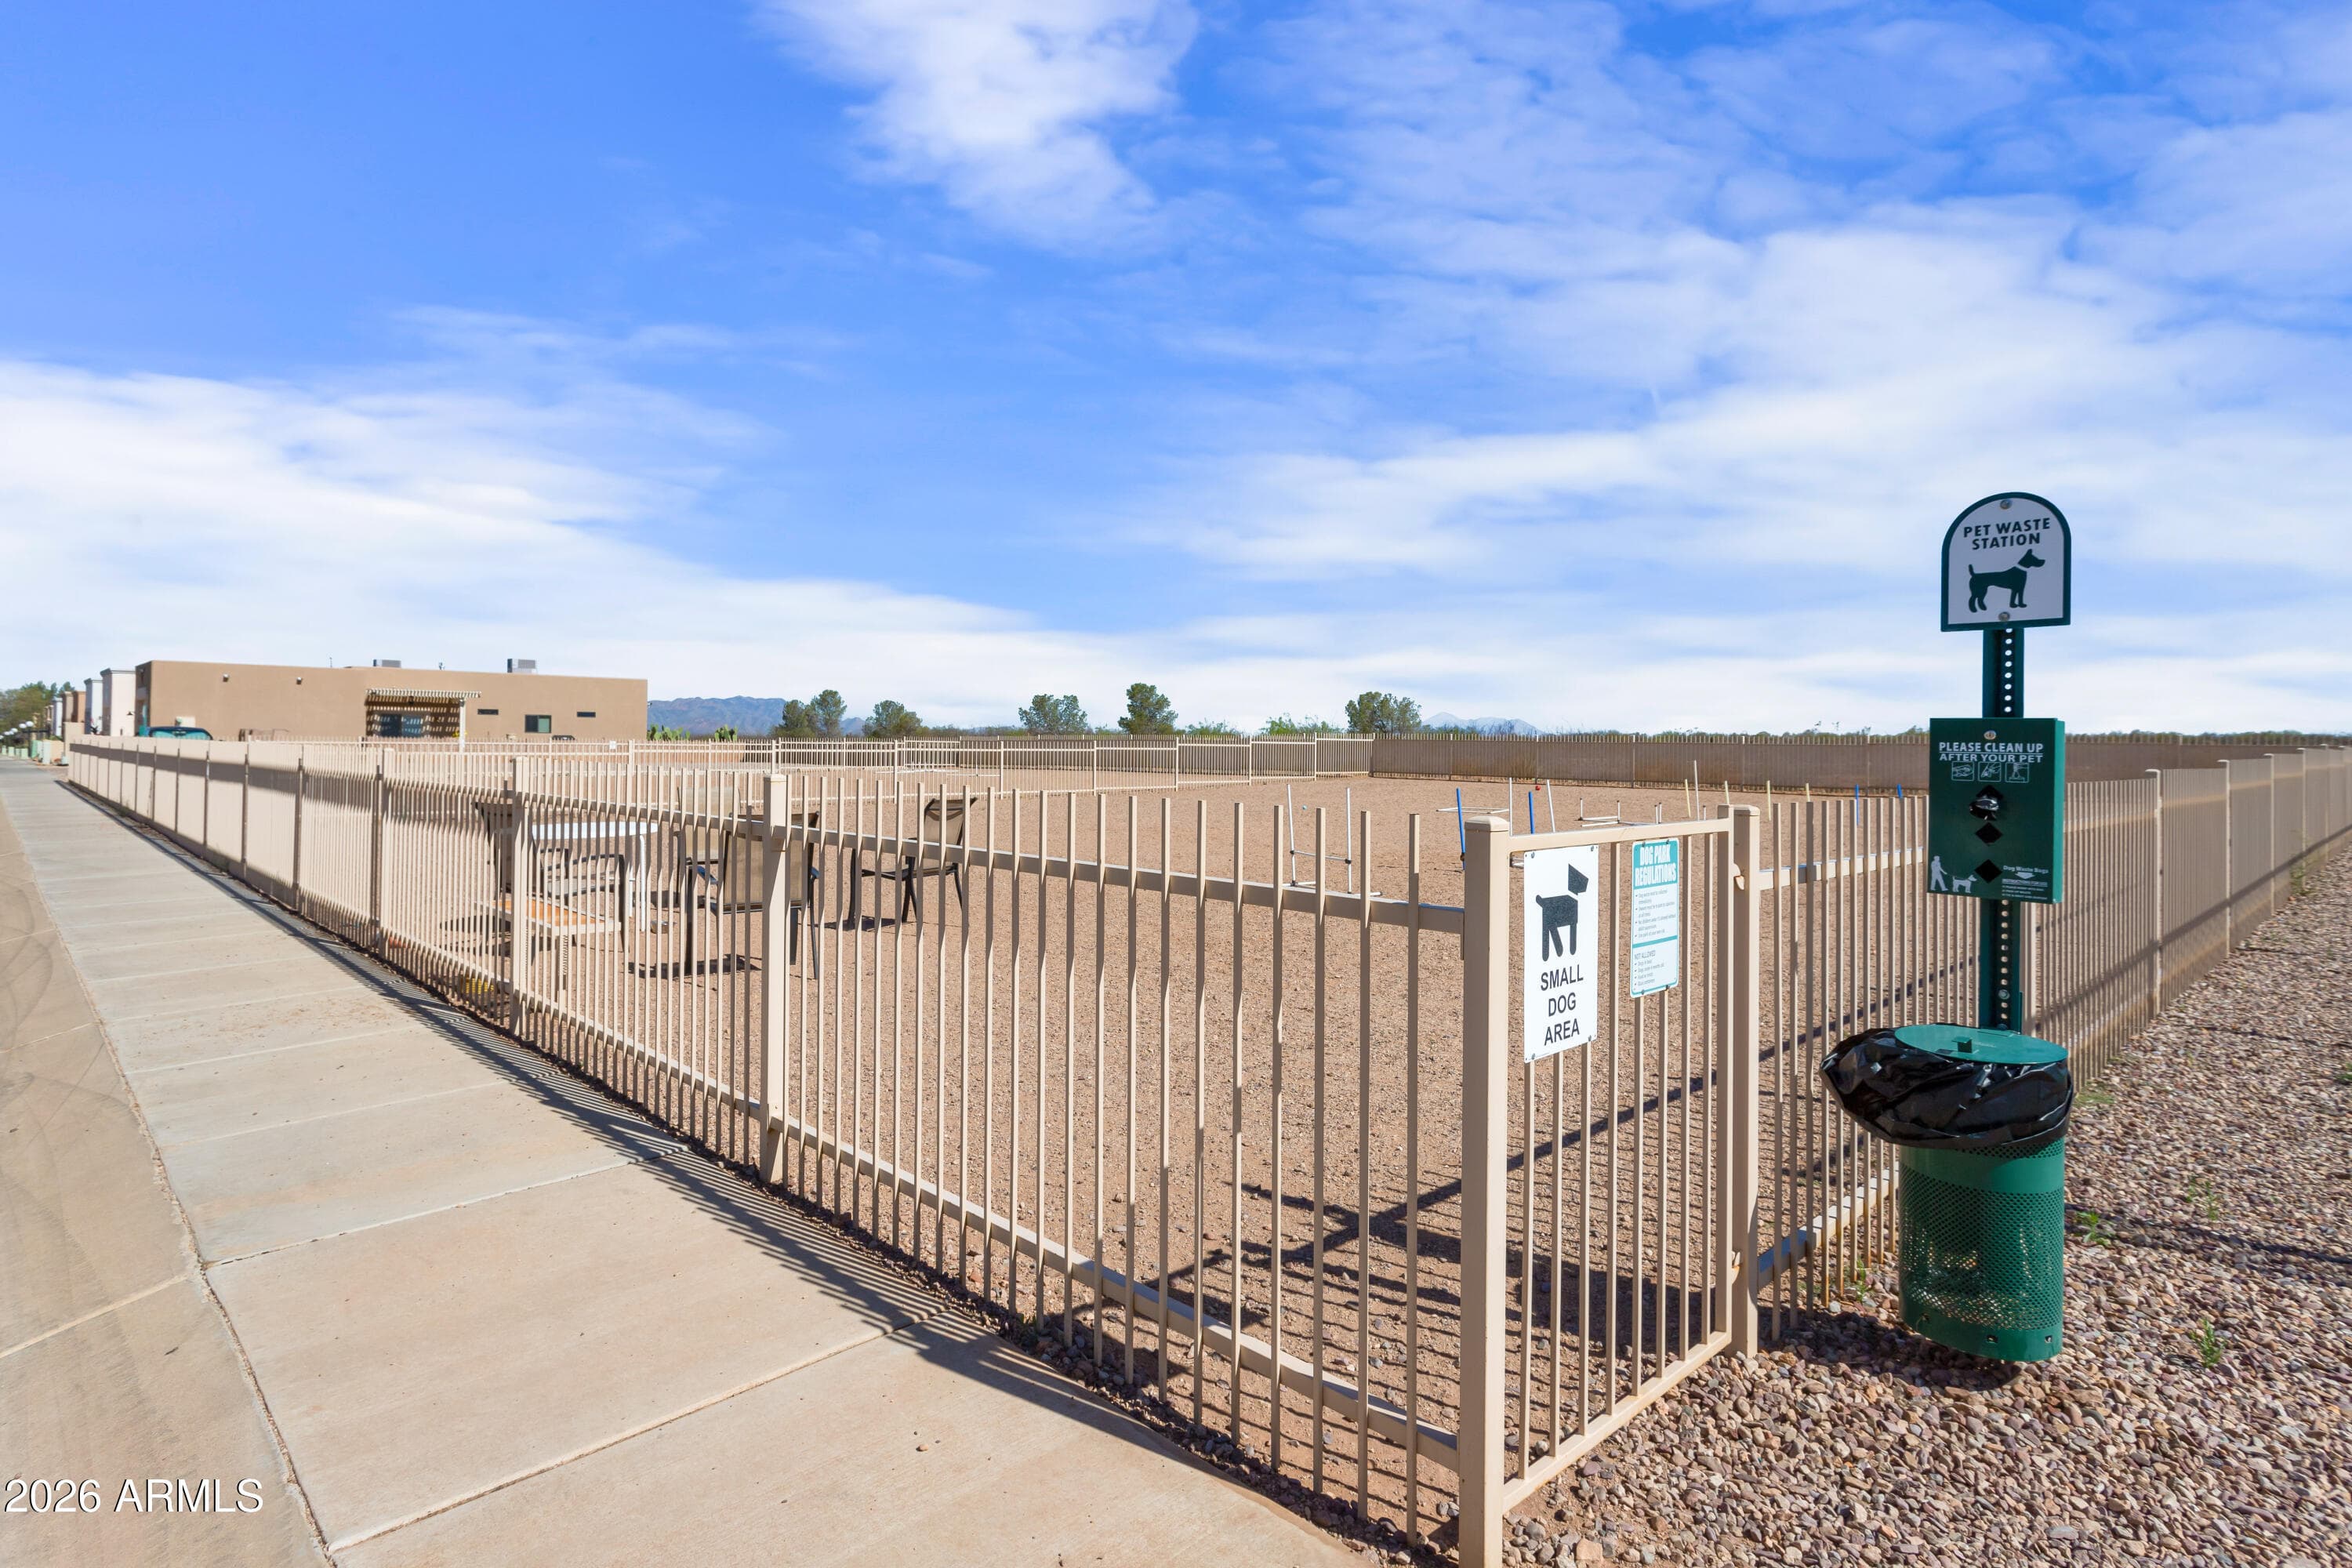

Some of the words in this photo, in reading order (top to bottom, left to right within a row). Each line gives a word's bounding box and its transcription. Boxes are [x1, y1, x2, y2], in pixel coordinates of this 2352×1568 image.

[1963, 524, 1991, 538] PET
[1996, 517, 2051, 535] WASTE
[1972, 532, 2041, 550] STATION
[1938, 742, 1981, 753] PLEASE
[1984, 742, 2023, 753] CLEAN
[2027, 743, 2044, 753] UP
[1939, 753, 1978, 762] AFTER
[1980, 753, 2015, 763] YOUR
[2019, 754, 2043, 764] PET
[1639, 846, 1653, 866] DOG
[1654, 844, 1671, 864] PARK
[1635, 862, 1676, 887] REGULATIONS
[1540, 964, 1584, 992] SMALL
[1548, 992, 1577, 1017] DOG
[1544, 1018, 1581, 1047] AREA
